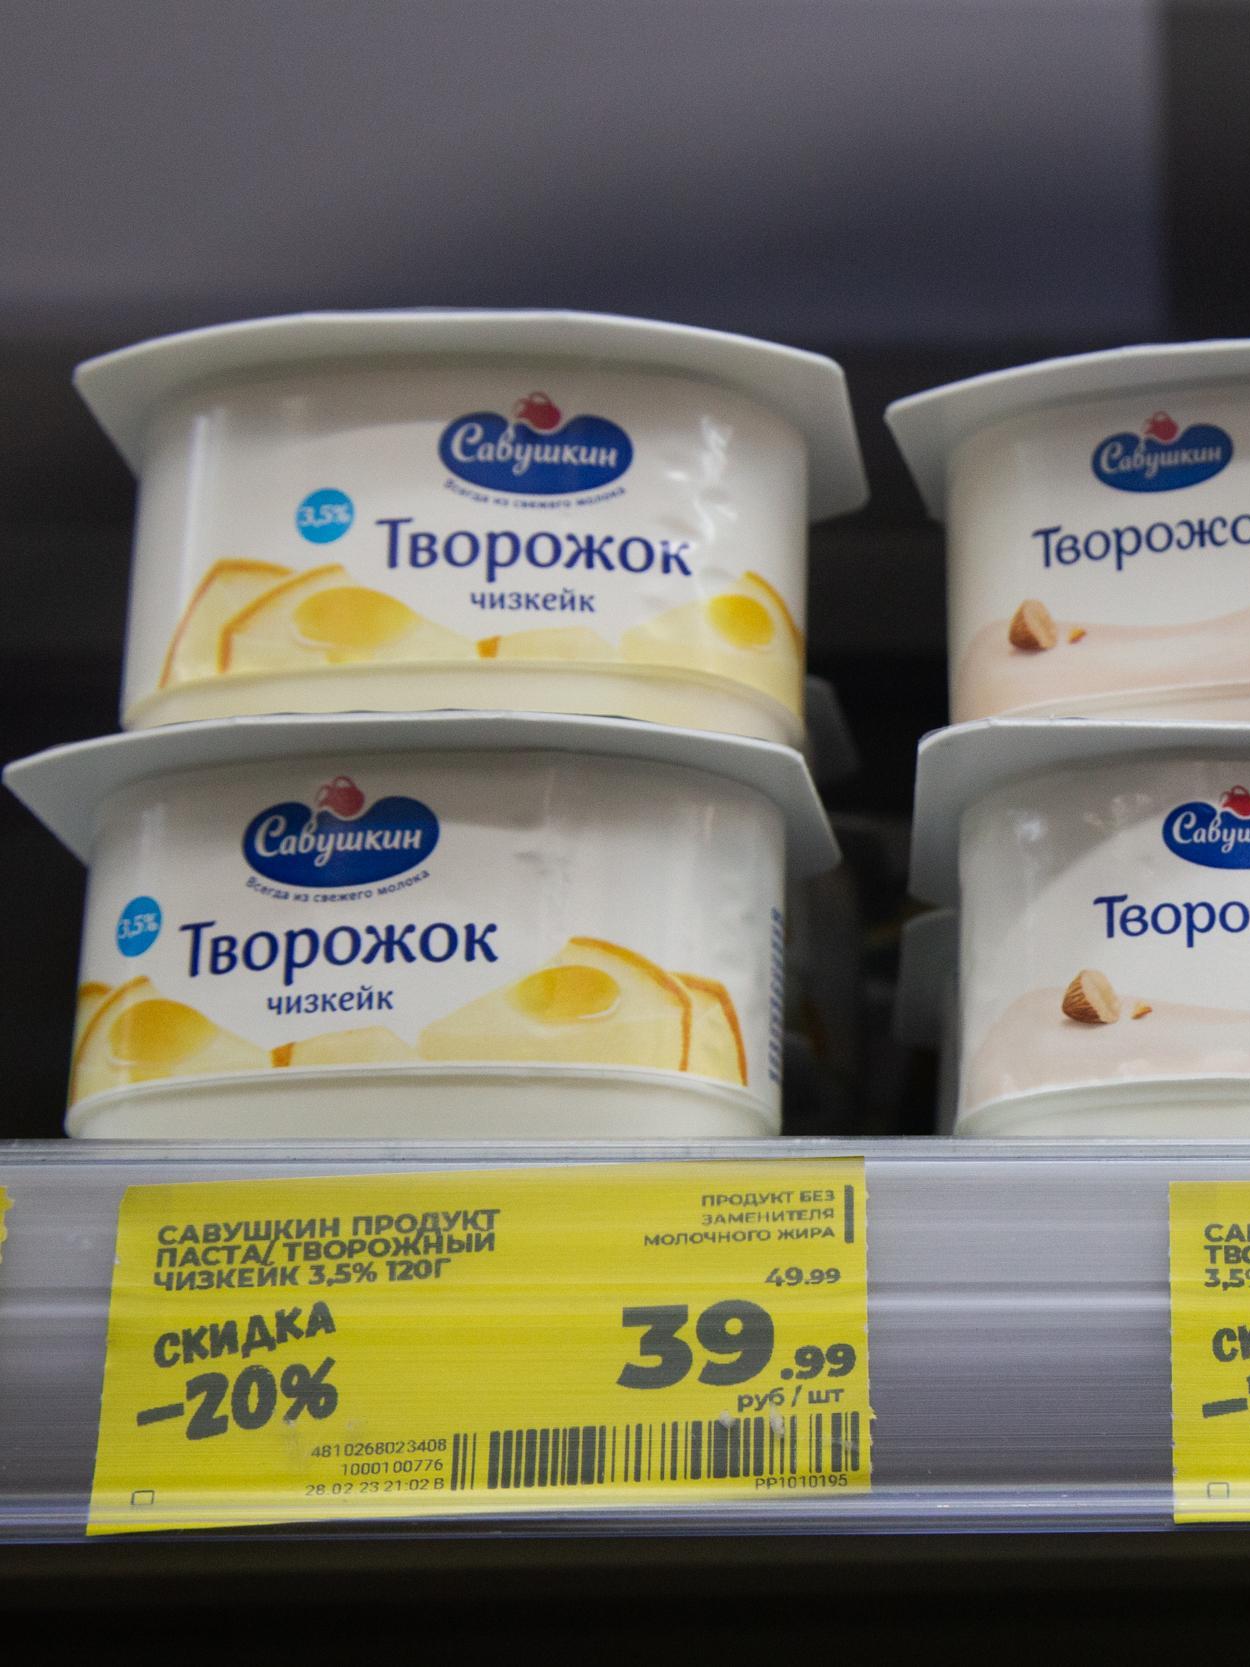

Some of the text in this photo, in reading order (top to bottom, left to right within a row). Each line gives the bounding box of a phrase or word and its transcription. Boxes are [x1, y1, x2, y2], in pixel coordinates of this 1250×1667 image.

[451, 422, 619, 476] Савушкин
[1101, 438, 1222, 479] Савушкин
[300, 501, 352, 528] 3,5%
[375, 517, 693, 583] Творожок
[469, 588, 596, 613] чизкейк
[254, 813, 422, 868] Савушкин
[246, 876, 289, 900] Всегда
[313, 889, 373, 903] свежего
[377, 869, 430, 896] молока
[118, 913, 159, 940] 3,5%
[178, 919, 499, 987] Творожок
[267, 985, 394, 1016] чизкейк
[701, 1189, 835, 1207] ПРОДУКТ БЕЗ
[158, 1209, 501, 1246] САВУШКИН ПРОДУКТ
[701, 1207, 835, 1226] ЗАМЕНИТЕЛЯ
[283, 1231, 496, 1262] ТВОРОЖНЫЙ
[643, 1226, 836, 1247] МОЛОЧНОГО ЖИРА
[153, 1257, 452, 1291] ЧИЗКЕЙК 3,5% 120Г
[764, 1266, 841, 1287] 49.99
[153, 1300, 336, 1368] СКИДКА
[136, 1356, 339, 1441] -20%
[737, 1387, 785, 1413] руб
[807, 1388, 845, 1405] шт
[311, 1438, 447, 1458] 4810268023408
[342, 1458, 443, 1476] 1000100776
